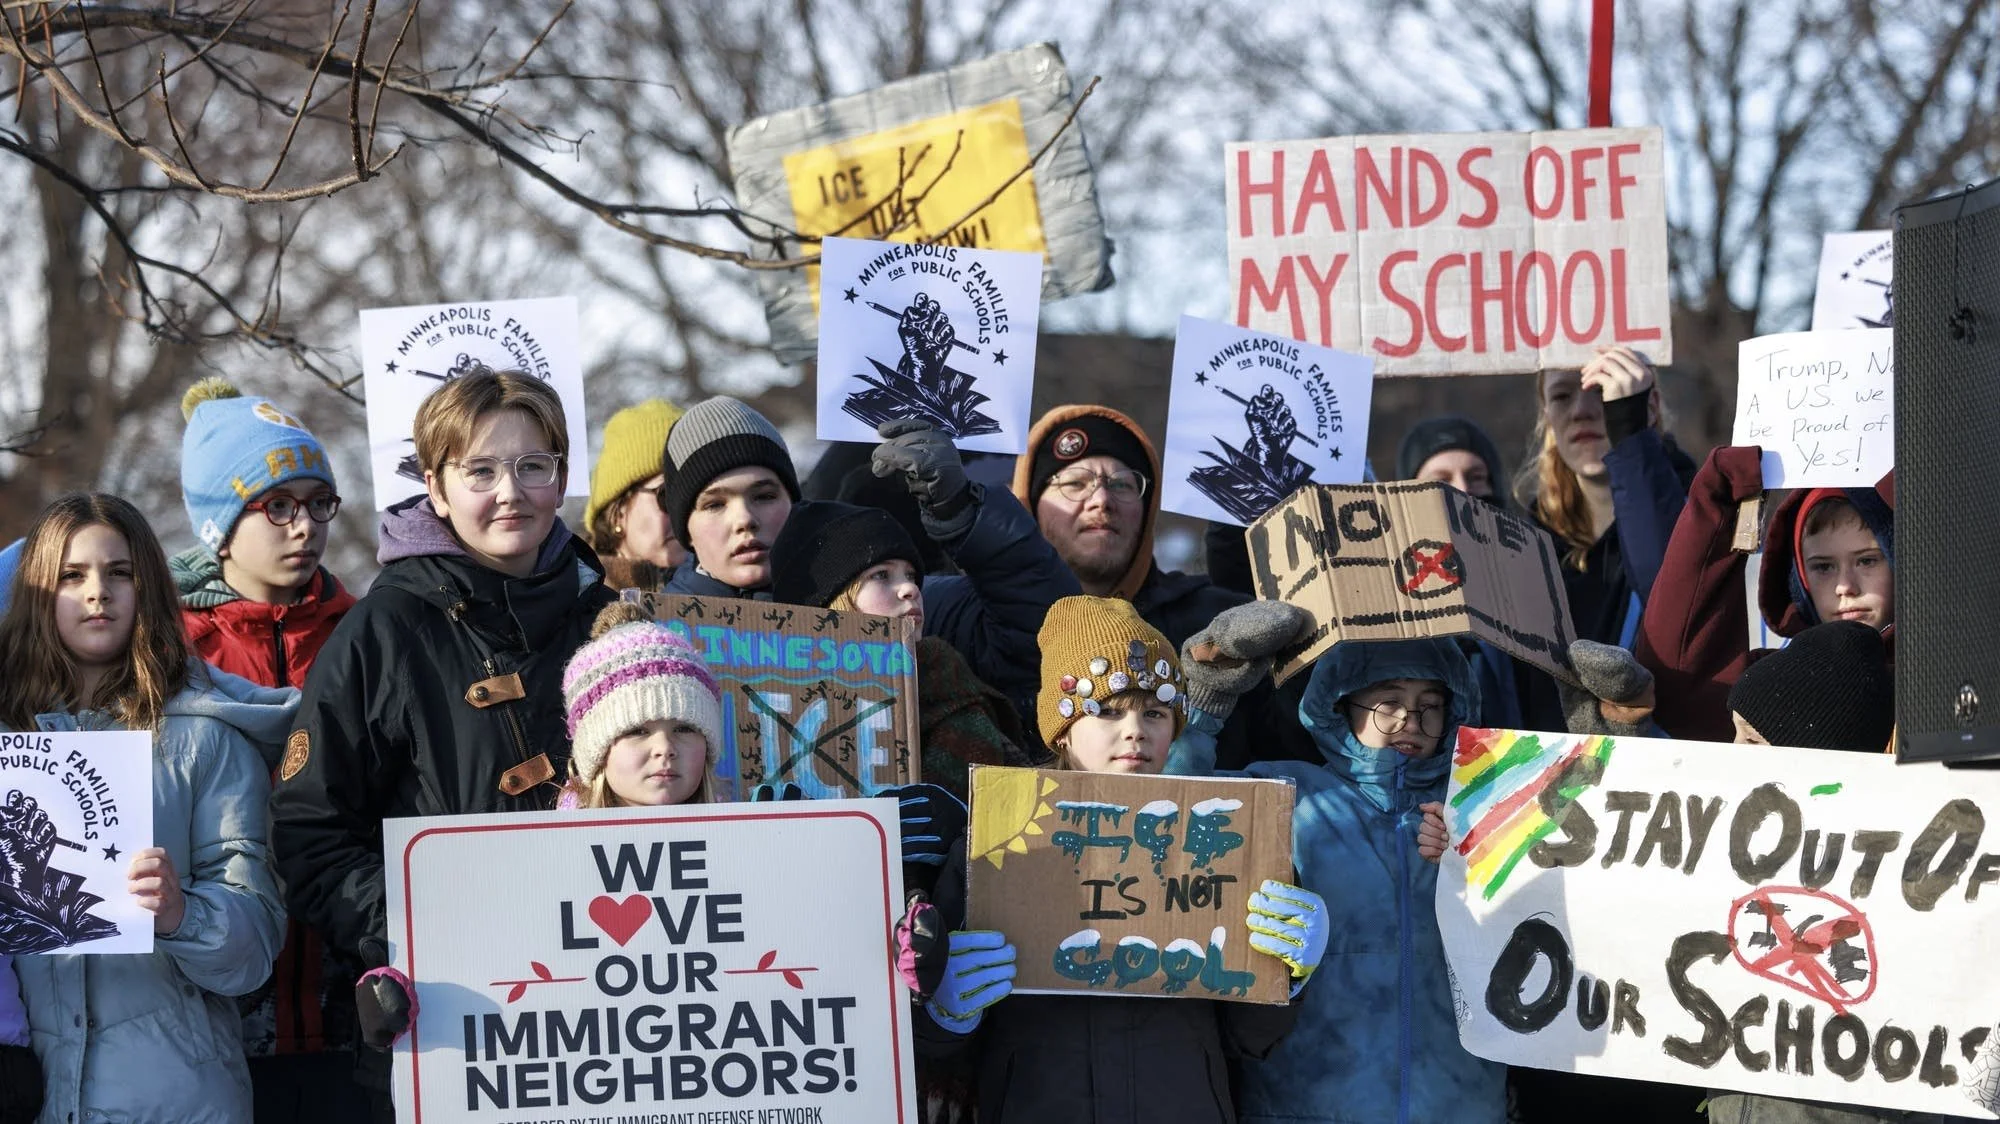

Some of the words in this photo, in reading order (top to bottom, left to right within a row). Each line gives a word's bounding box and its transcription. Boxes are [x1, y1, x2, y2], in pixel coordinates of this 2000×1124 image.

[818, 165, 868, 207] ICE
[1237, 146, 1499, 238] HANDS
[1523, 144, 1641, 221] OFF
[858, 243, 958, 287] MINNEAPOLIS
[967, 261, 1009, 335] FAMILIES
[888, 266, 904, 280] FOR
[912, 261, 962, 284] PUBLIC
[962, 280, 991, 345] SCHOOLS
[1236, 253, 1350, 348] MY
[1372, 247, 1662, 359] SCHOOL
[397, 306, 491, 356] MINNEAPOLIS
[503, 317, 552, 381] FAMILIES
[426, 333, 443, 346] FOR
[449, 323, 498, 340] PUBLIC
[500, 336, 533, 374] SCHOO
[1755, 348, 1849, 384] Trump,
[1209, 338, 1300, 372] MINNEAPOLIS
[1308, 363, 1343, 434] FAMILIES
[1237, 358, 1253, 369] FOR
[1259, 355, 1303, 380] PUBLIC
[1303, 379, 1328, 440] SCHOOLS
[1747, 393, 1761, 416] A
[1749, 420, 1774, 439] be
[1863, 414, 1890, 432] of
[1796, 436, 1863, 476] Yes!
[1283, 486, 1391, 571] NO
[1443, 487, 1528, 553] ICE
[748, 691, 893, 799] ICE
[0, 755, 59, 776] PUBLIC
[61, 771, 99, 841] SCHOOLS
[65, 749, 119, 828] FAMILIES
[1051, 797, 1245, 870] ICE
[1528, 754, 1728, 876] STAY
[1729, 781, 1903, 899] OUT
[590, 840, 708, 893] WE
[1165, 874, 1238, 913] NOT
[595, 952, 719, 998] OUR
[1053, 926, 1257, 998] COOL
[1485, 911, 1647, 1035] OUR
[463, 997, 857, 1063] IMMIGRANT
[466, 1046, 859, 1112] NEIGHBORS!
[758, 1106, 823, 1124] NETWORK
